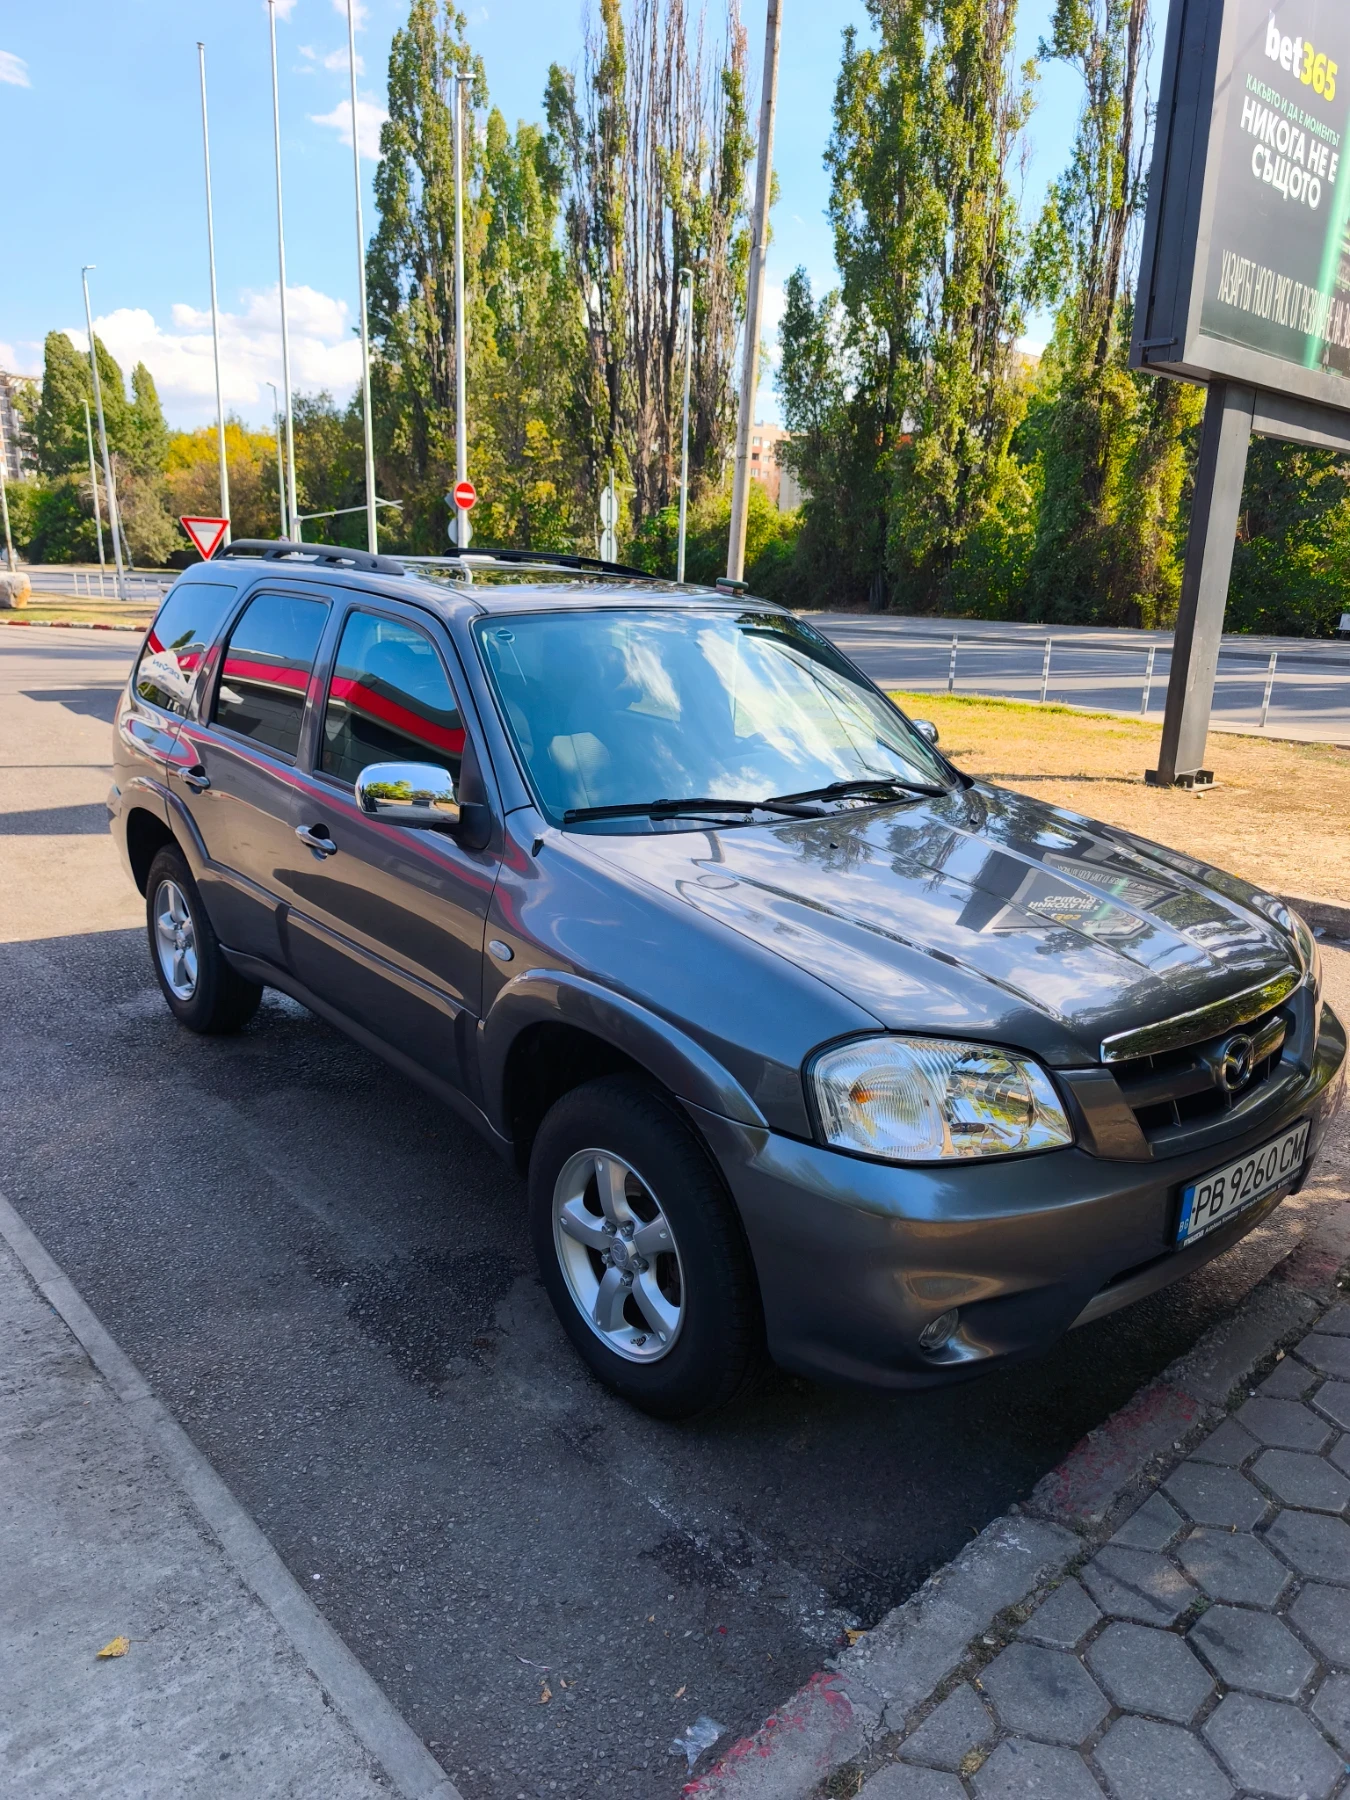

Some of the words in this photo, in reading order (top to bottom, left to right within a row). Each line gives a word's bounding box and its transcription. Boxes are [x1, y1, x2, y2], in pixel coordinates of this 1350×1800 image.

[1265, 9, 1338, 101] bet365
[1240, 95, 1305, 166] НИКОГА
[1307, 139, 1329, 178] НЕ
[1328, 152, 1339, 184] Е
[1246, 73, 1281, 108] КАКЪВТО
[1281, 97, 1288, 114] И
[1287, 103, 1298, 121] ДА
[1299, 109, 1304, 124] Е
[1303, 113, 1341, 147] МОМЕНТЪТ
[1252, 144, 1321, 209] СЪЩОТО
[1217, 249, 1256, 312] ХАЗАРТЪТ
[1252, 265, 1276, 320] НОСИ
[1272, 274, 1294, 327] РИСК
[1289, 281, 1303, 329] ОТ
[1179, 1219, 1190, 1232] BG
[1194, 1177, 1225, 1226] PB
[1230, 1146, 1277, 1206] 9260
[1279, 1128, 1306, 1173] CM
